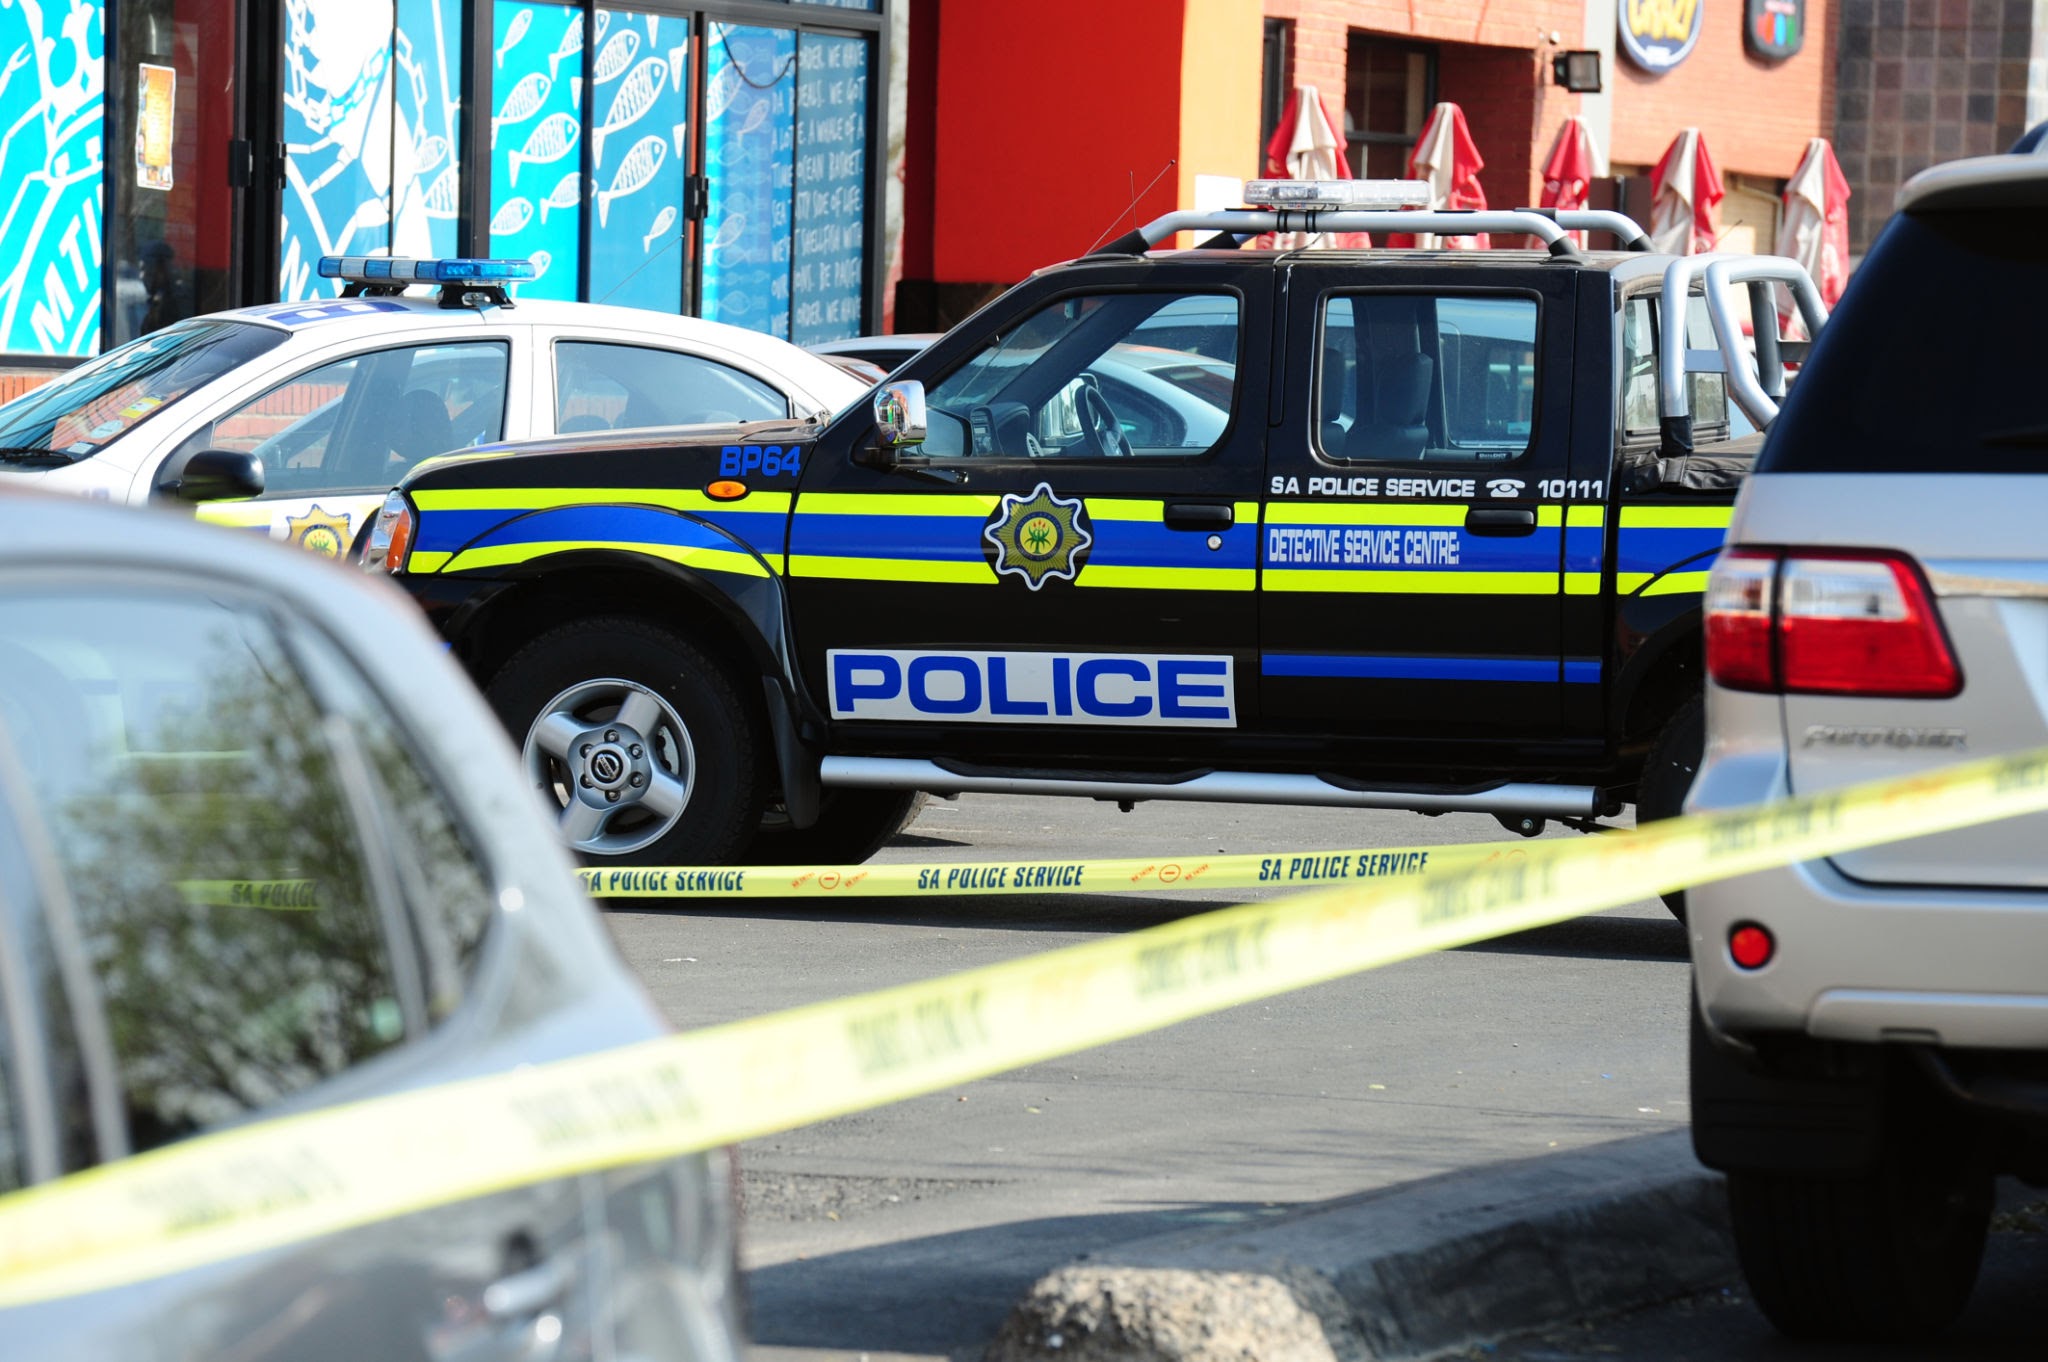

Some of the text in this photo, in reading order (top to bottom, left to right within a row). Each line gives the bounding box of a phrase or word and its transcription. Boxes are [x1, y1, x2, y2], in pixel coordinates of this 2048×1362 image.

[719, 446, 800, 476] BP64
[1270, 476, 1603, 498] SA POLICE SERVICE 10111
[1269, 529, 1340, 563] DETECTIVE
[1344, 530, 1400, 564] SERVICE
[834, 654, 1230, 719] POLICE
[918, 865, 1085, 889] SA POLICE SERVICE
[1259, 852, 1429, 881] SA POLICE SERVICE
[610, 871, 669, 891] POLICE
[675, 871, 746, 891] SERVICE
[231, 884, 253, 905] SA
